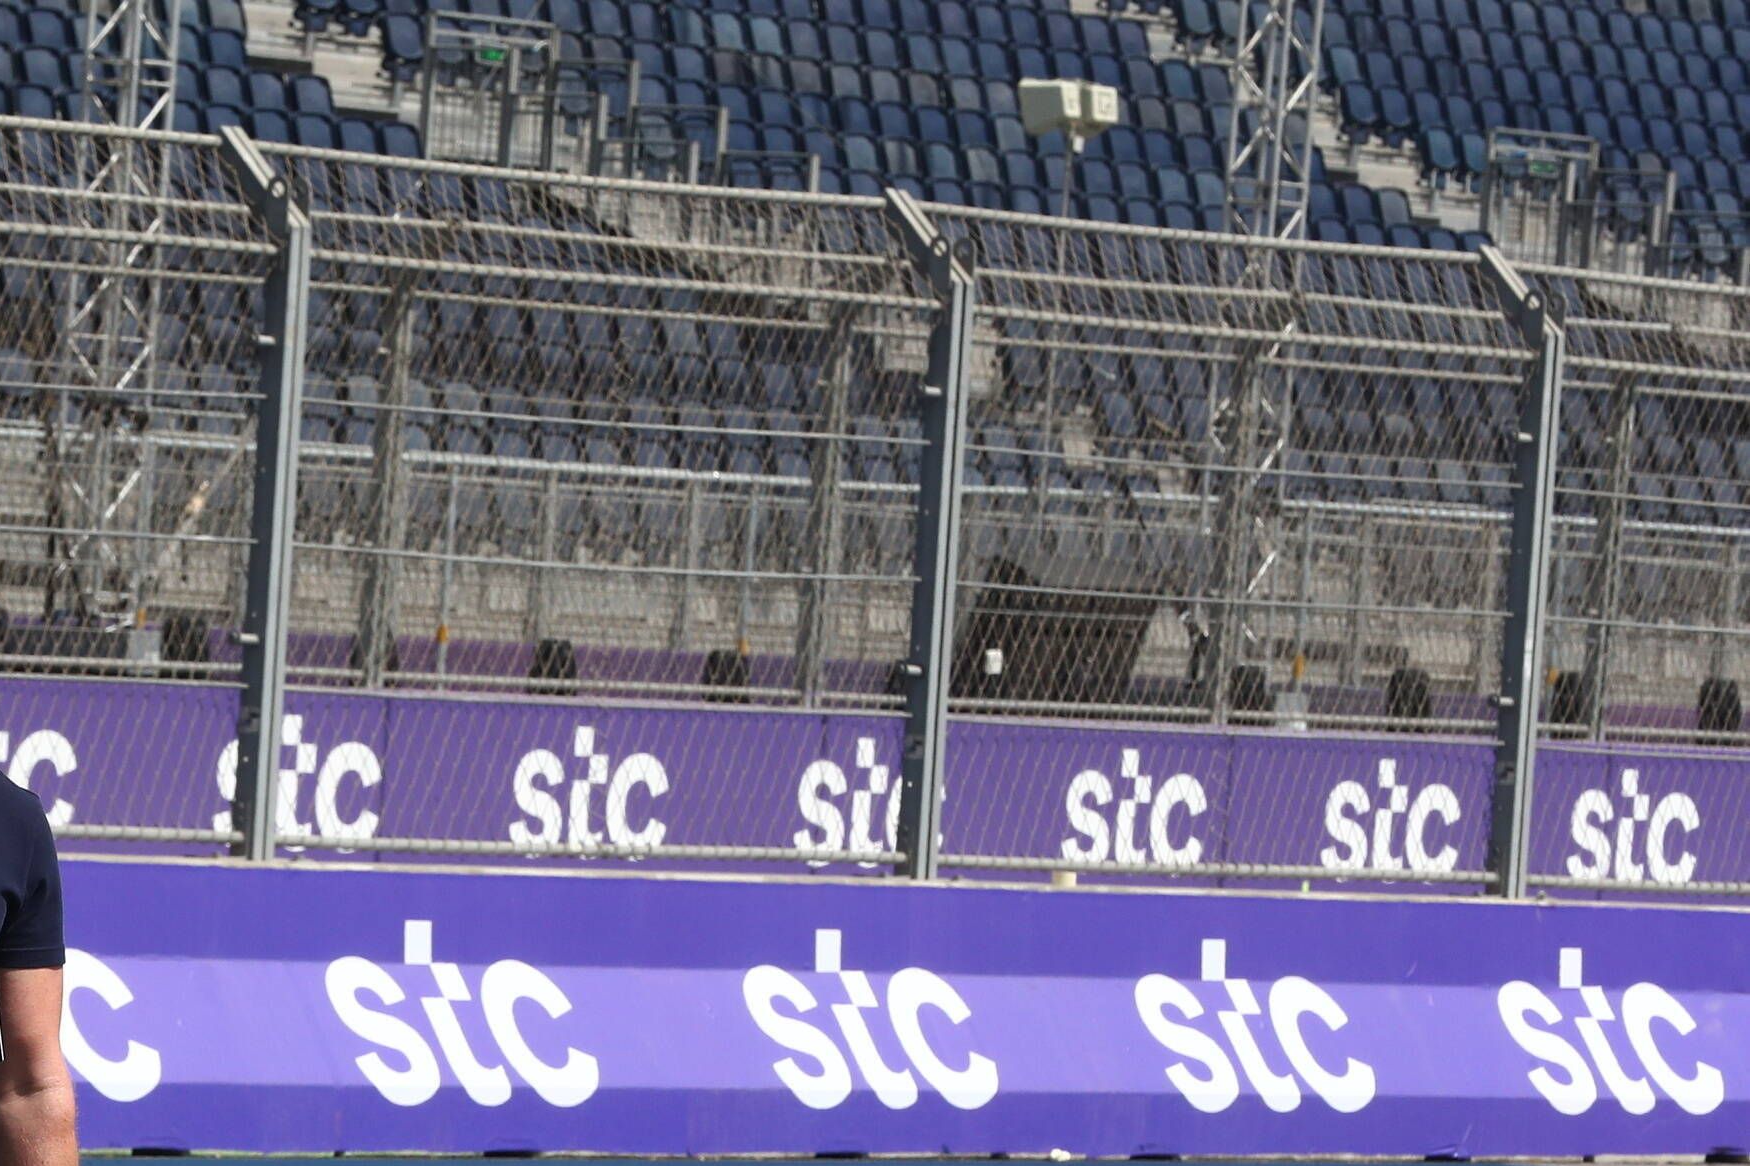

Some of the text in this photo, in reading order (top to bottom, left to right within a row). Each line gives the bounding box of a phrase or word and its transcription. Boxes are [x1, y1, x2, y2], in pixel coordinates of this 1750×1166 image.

[508, 725, 669, 860] stc
[1061, 748, 1208, 877] stc
[1320, 758, 1461, 882] stc
[1566, 768, 1701, 887] stc
[324, 919, 600, 1107] stc
[742, 928, 1000, 1110] stc
[1134, 938, 1377, 1113] stc
[1497, 947, 1725, 1115] stc
